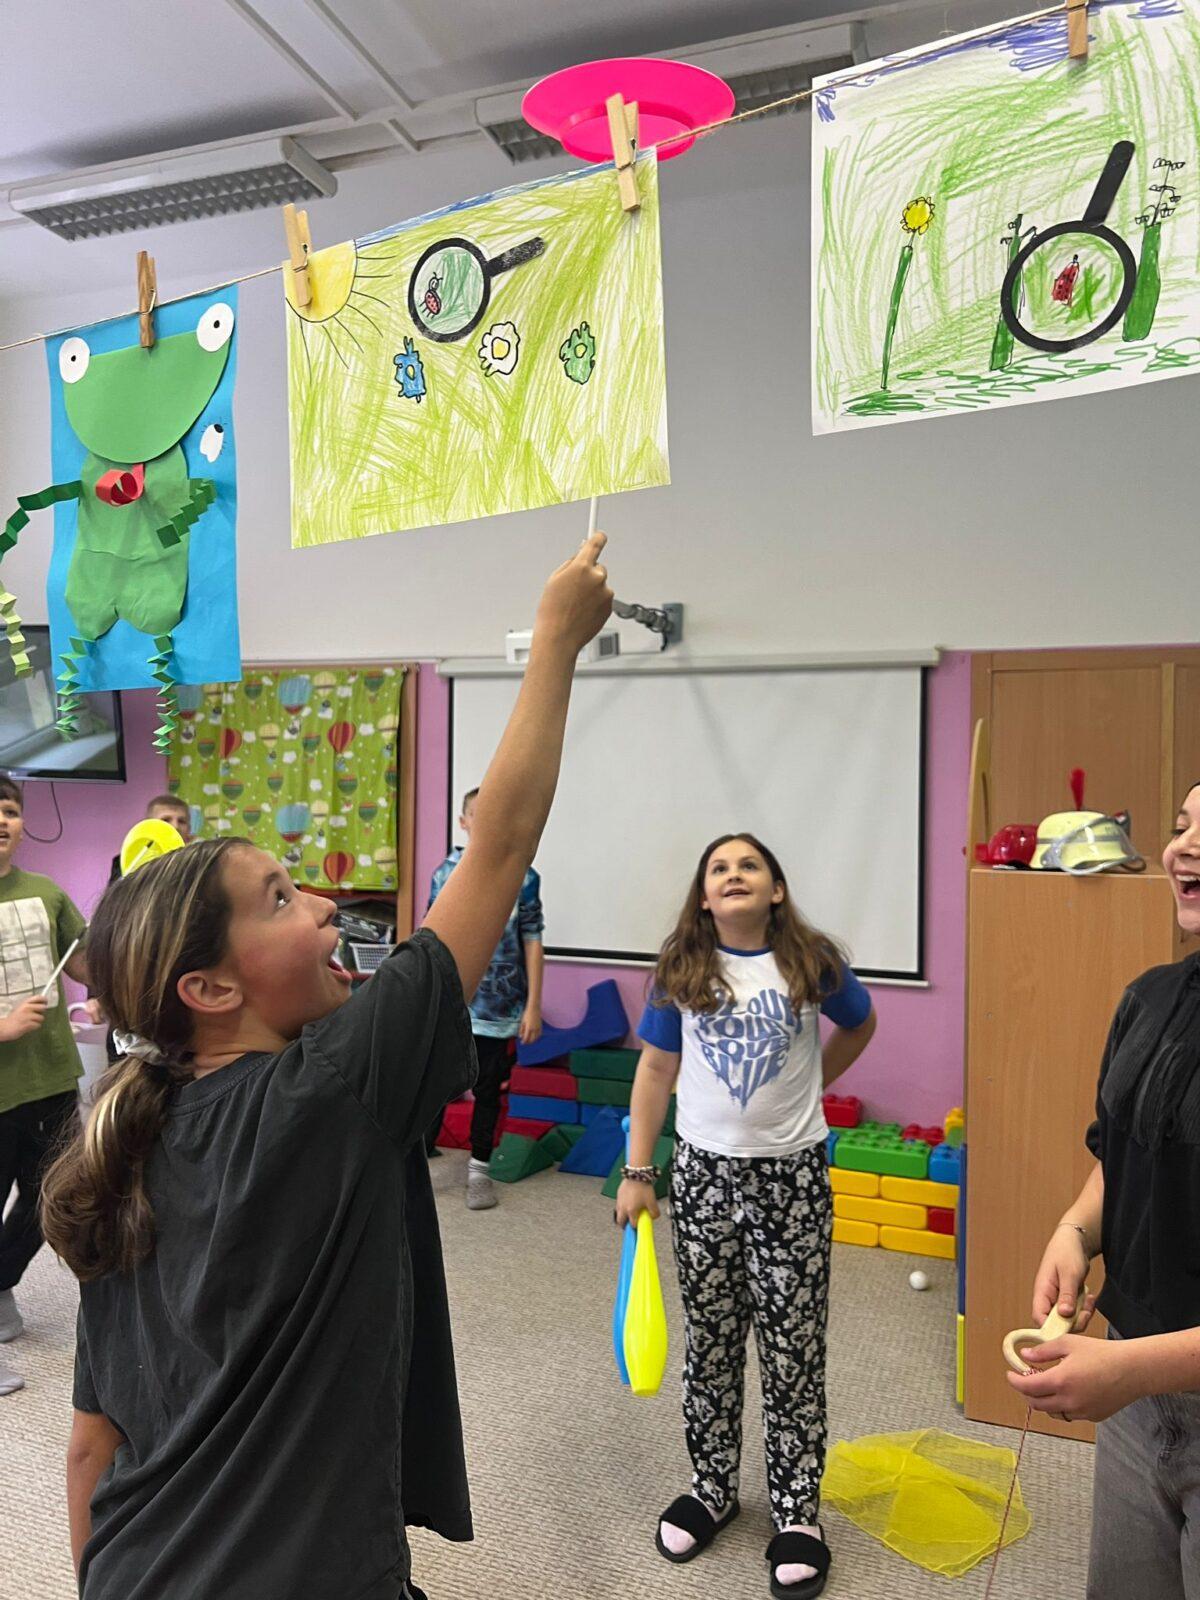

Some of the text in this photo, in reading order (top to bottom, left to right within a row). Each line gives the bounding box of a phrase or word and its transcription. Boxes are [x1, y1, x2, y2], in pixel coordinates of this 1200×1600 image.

[698, 1015, 790, 1041] YOUR
[694, 1029, 790, 1064] LOVE
[701, 1044, 789, 1107] BLUE
